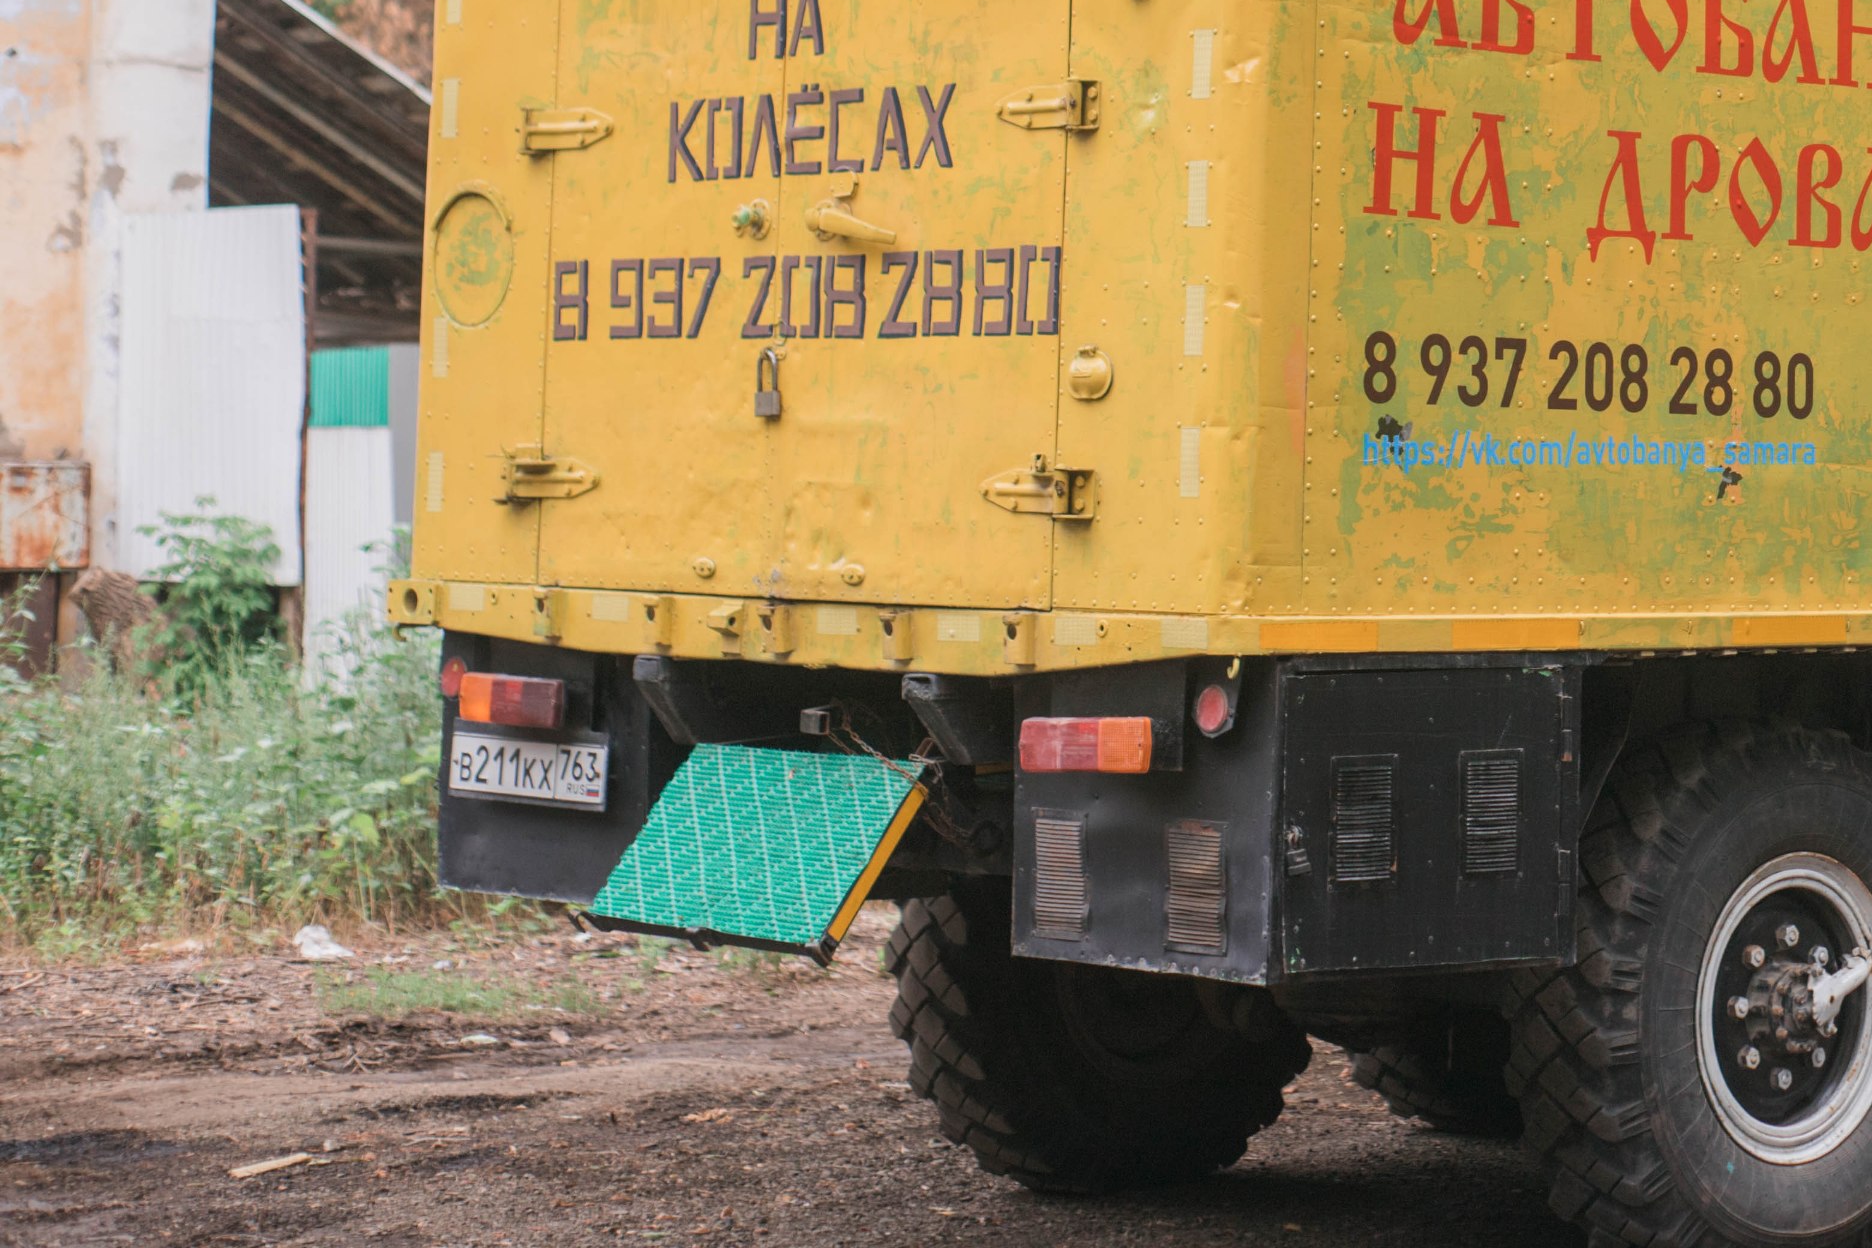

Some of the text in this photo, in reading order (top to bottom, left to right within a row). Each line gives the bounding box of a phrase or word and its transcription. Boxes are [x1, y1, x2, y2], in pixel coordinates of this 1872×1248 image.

[667, 82, 957, 184] КОЛЁСАХ
[1362, 100, 1521, 229] НА
[553, 258, 590, 342] 8
[609, 255, 722, 340] 937
[1362, 330, 1815, 420] 8 937 208 28 80
[1362, 429, 1817, 475] https://vk.com/avtobanya_samara
[560, 750, 599, 783] 763
[567, 782, 586, 796] RUS
